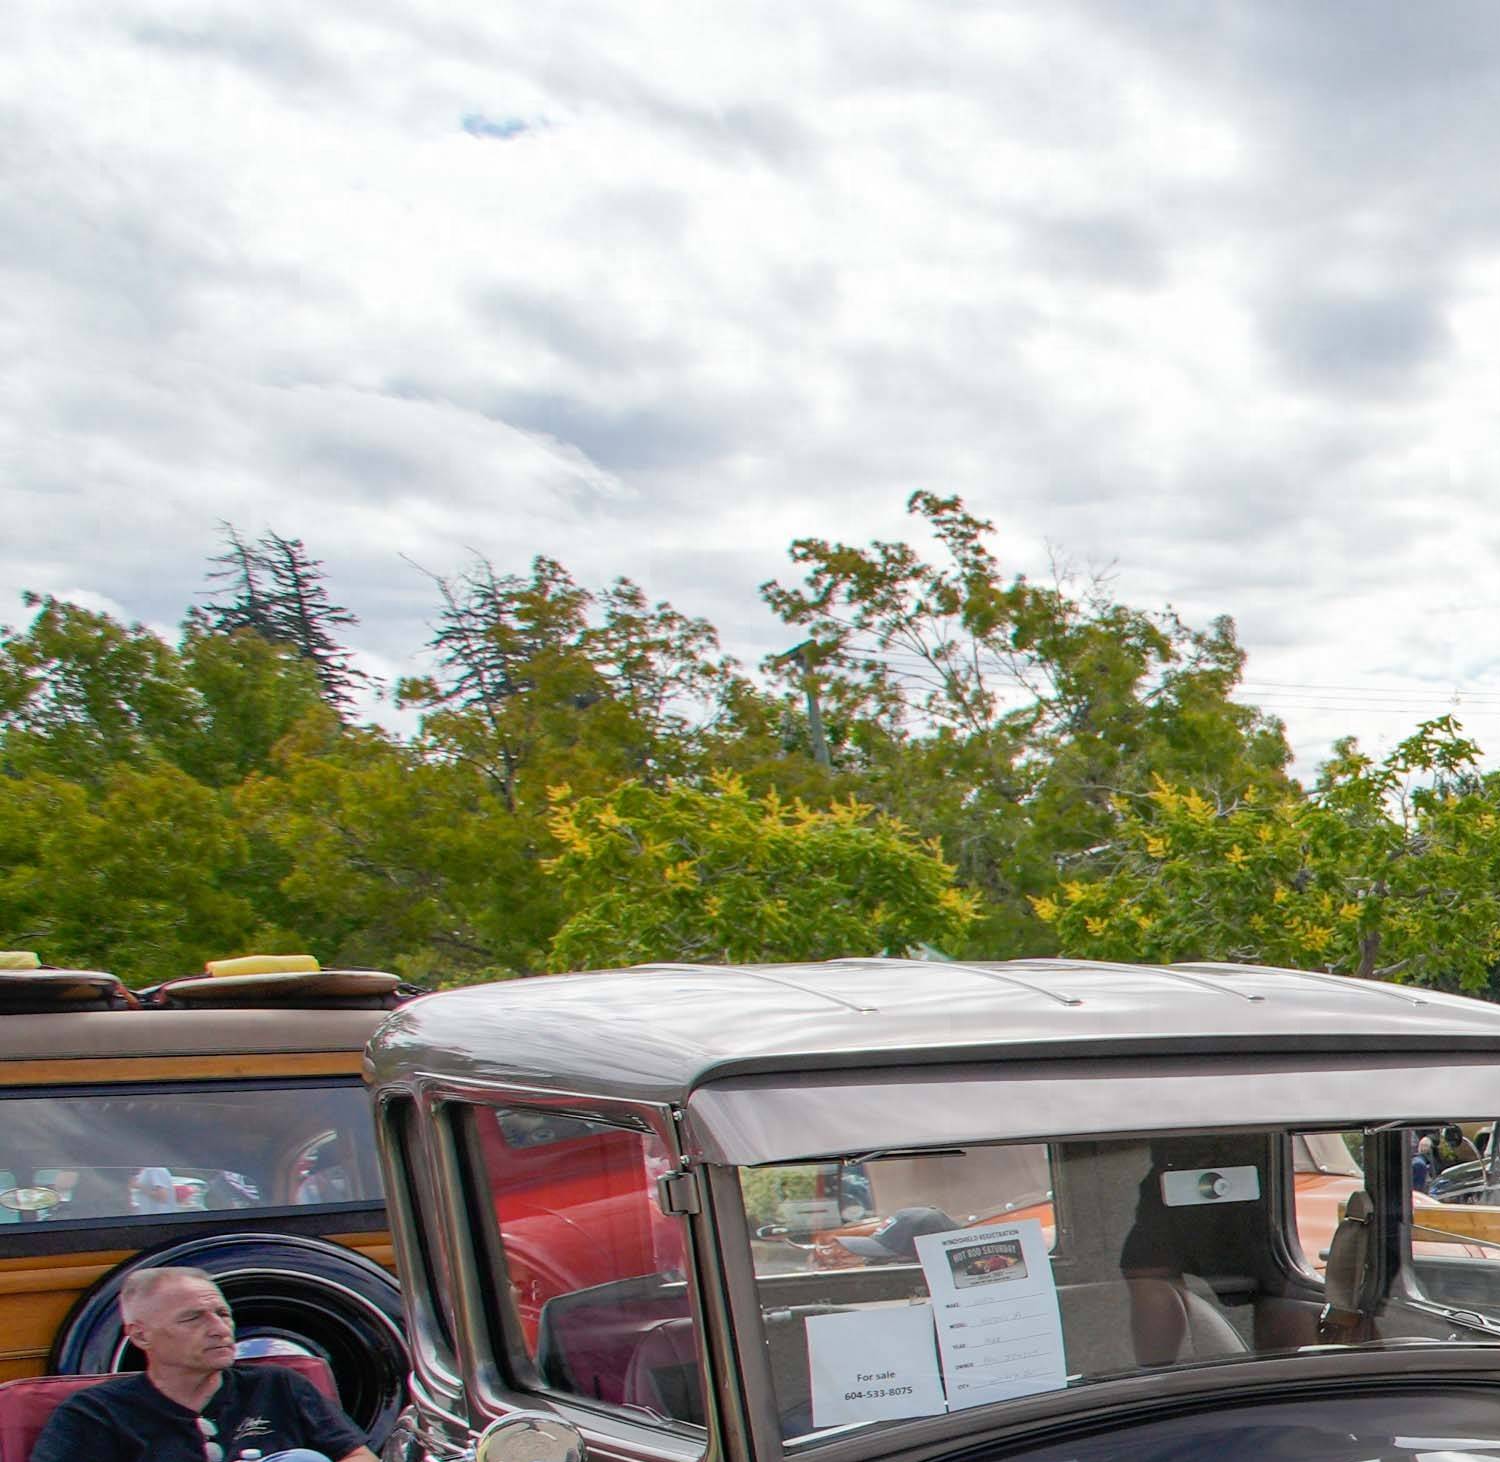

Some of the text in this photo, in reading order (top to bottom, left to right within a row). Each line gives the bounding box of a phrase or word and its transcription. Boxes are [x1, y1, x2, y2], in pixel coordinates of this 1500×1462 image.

[856, 1370, 896, 1382] For sale
[844, 1386, 913, 1401] 604-533-8075
